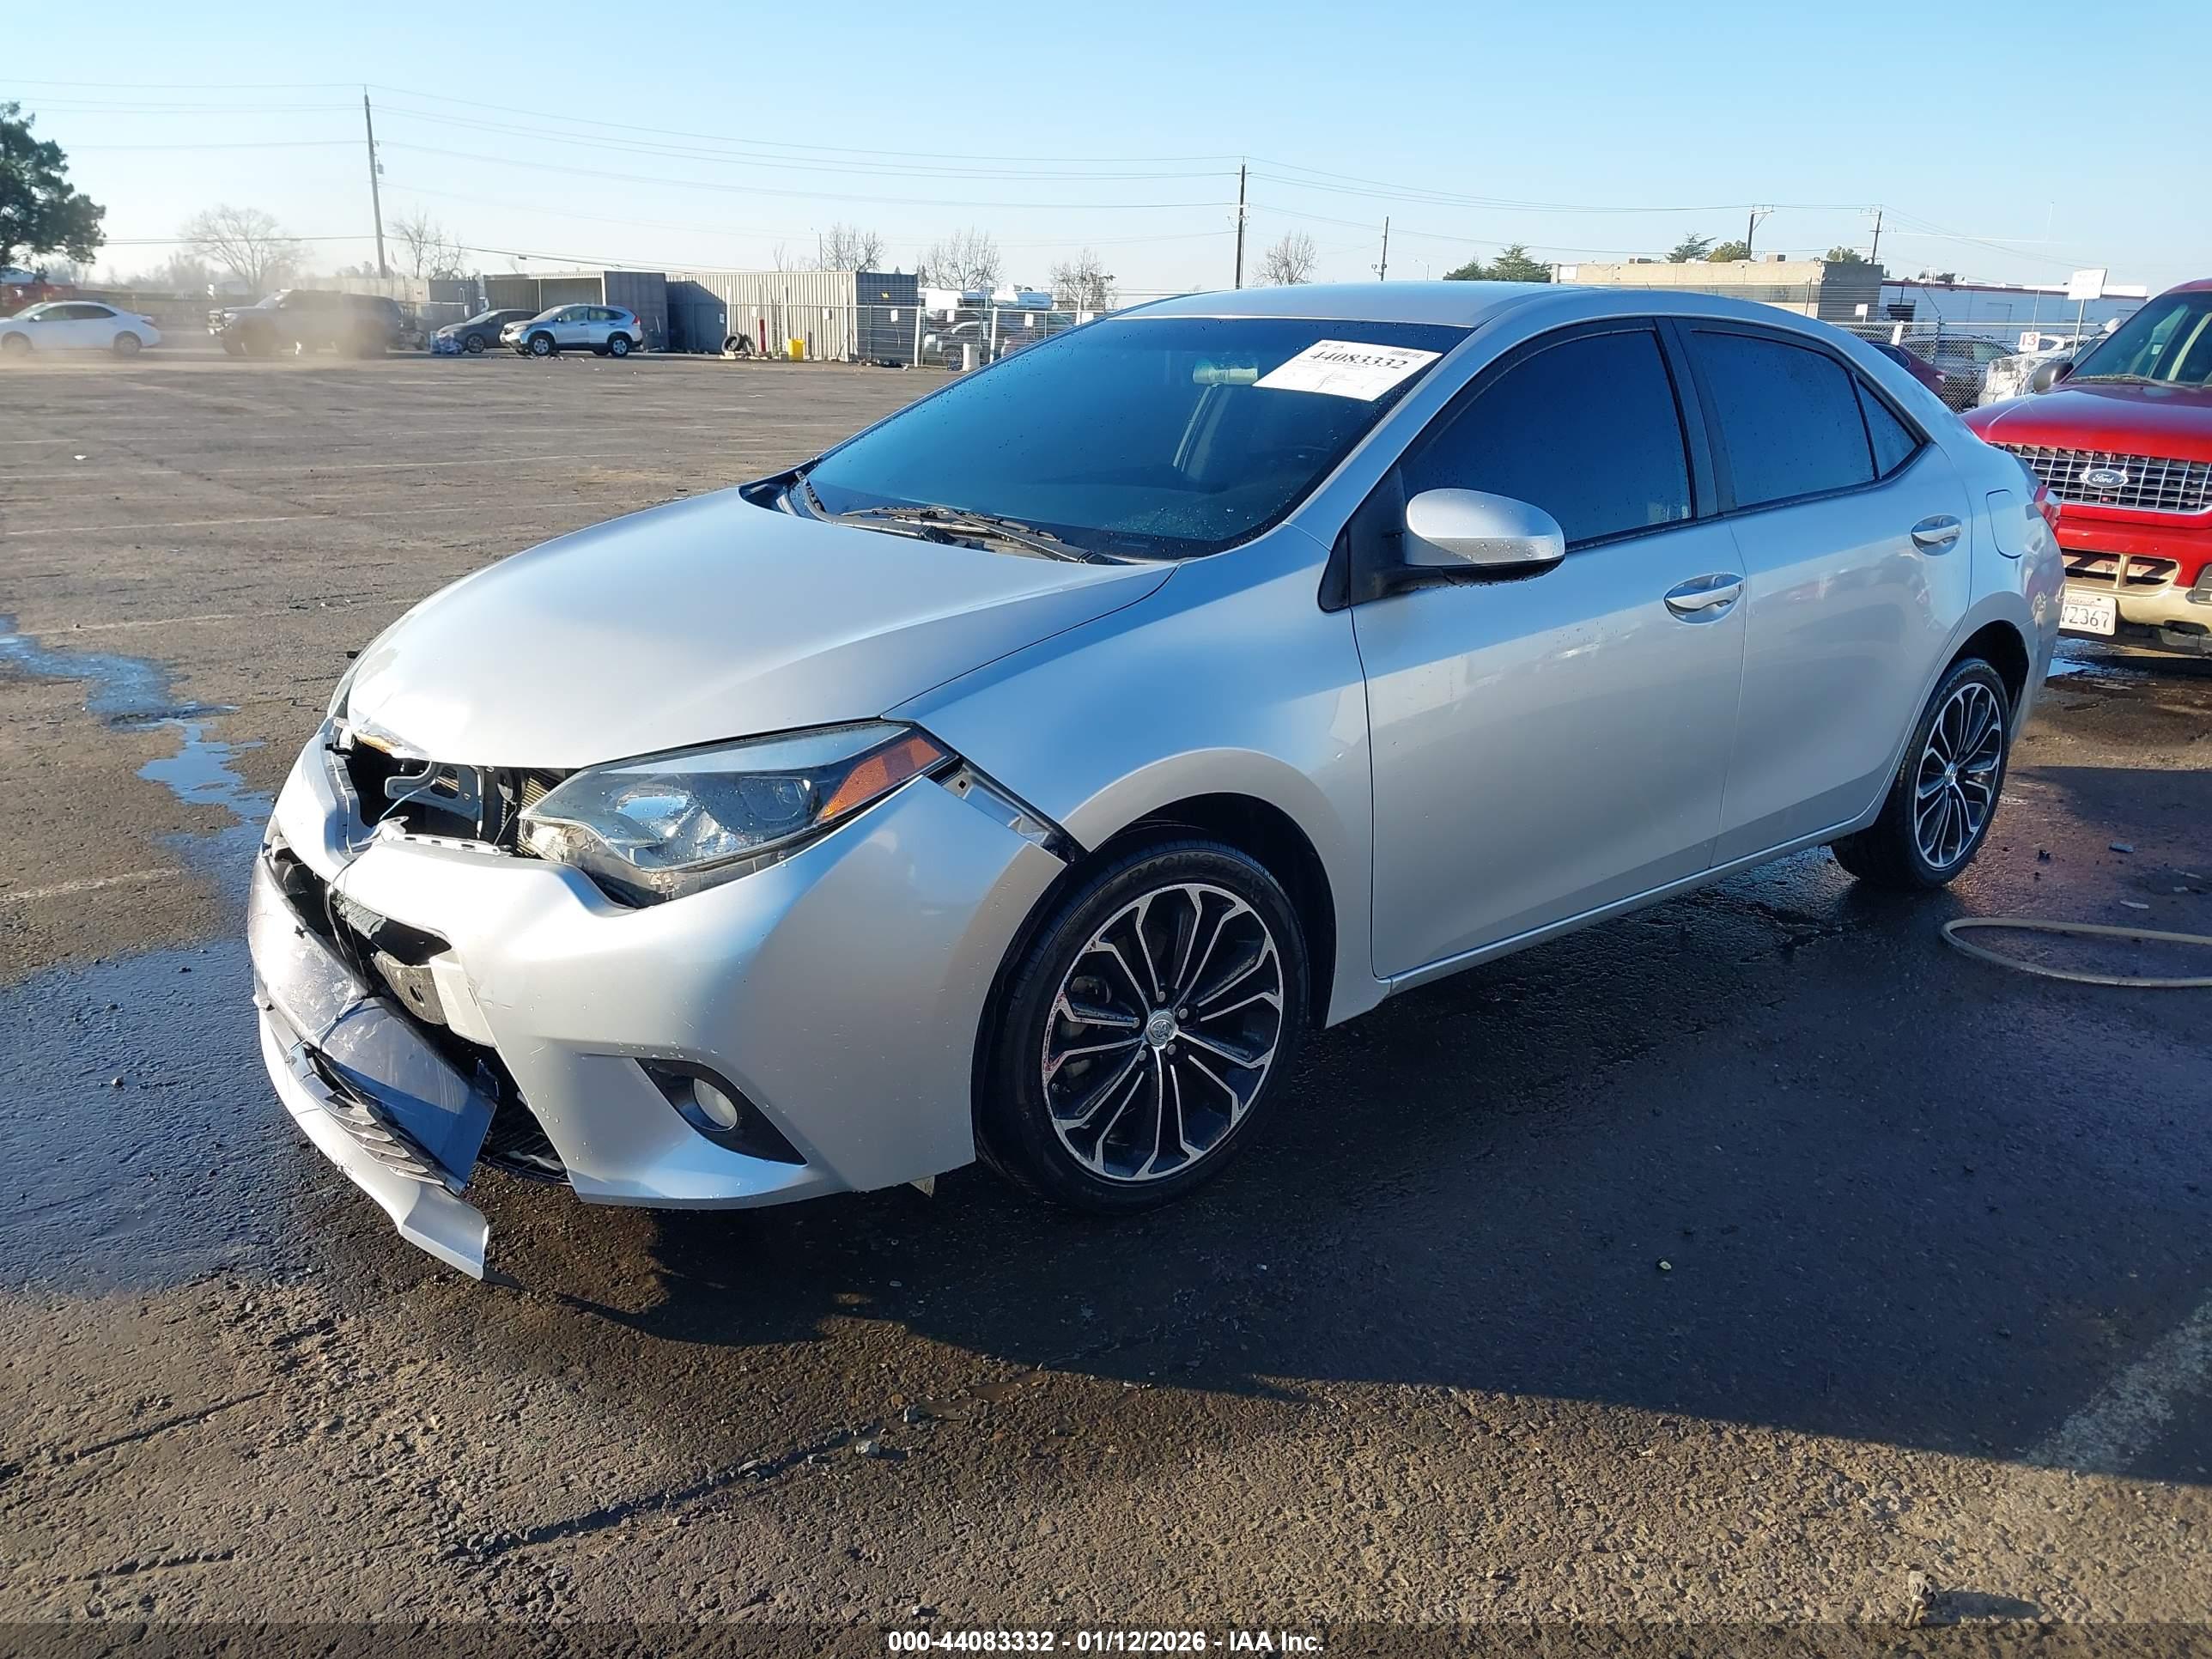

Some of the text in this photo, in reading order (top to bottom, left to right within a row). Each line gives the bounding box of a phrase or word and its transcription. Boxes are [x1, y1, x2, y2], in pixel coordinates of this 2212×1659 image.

[2021, 333, 2038, 346] 13
[1310, 350, 1409, 369] 44083332
[2092, 473, 2115, 483] Ford
